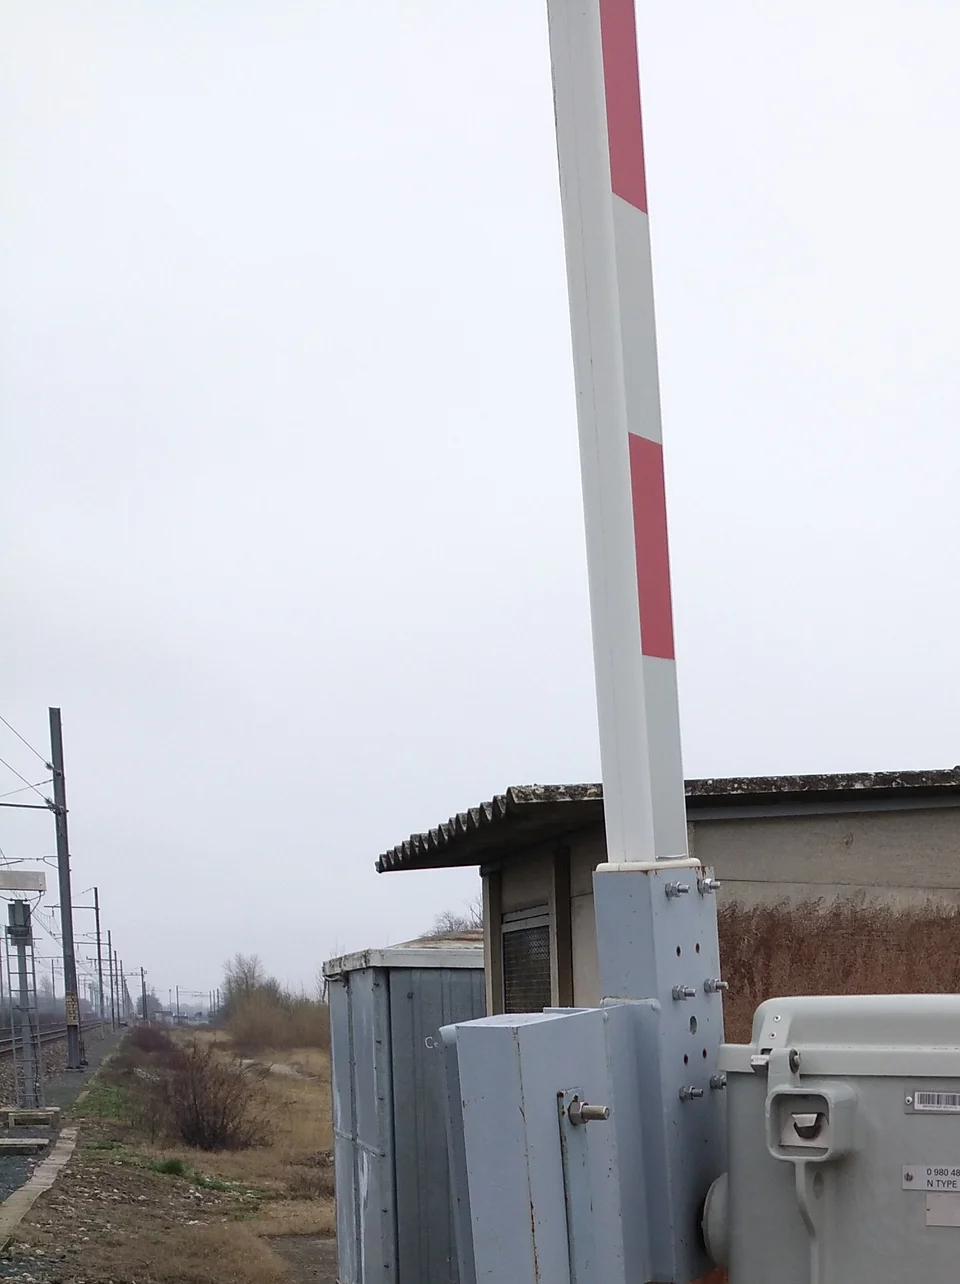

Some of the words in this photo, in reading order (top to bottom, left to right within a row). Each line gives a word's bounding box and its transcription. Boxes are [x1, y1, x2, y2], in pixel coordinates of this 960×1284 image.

[926, 1168, 932, 1176] 0
[933, 1168, 949, 1177] 980
[926, 1179, 933, 1188] N
[935, 1180, 957, 1188] TYPE
